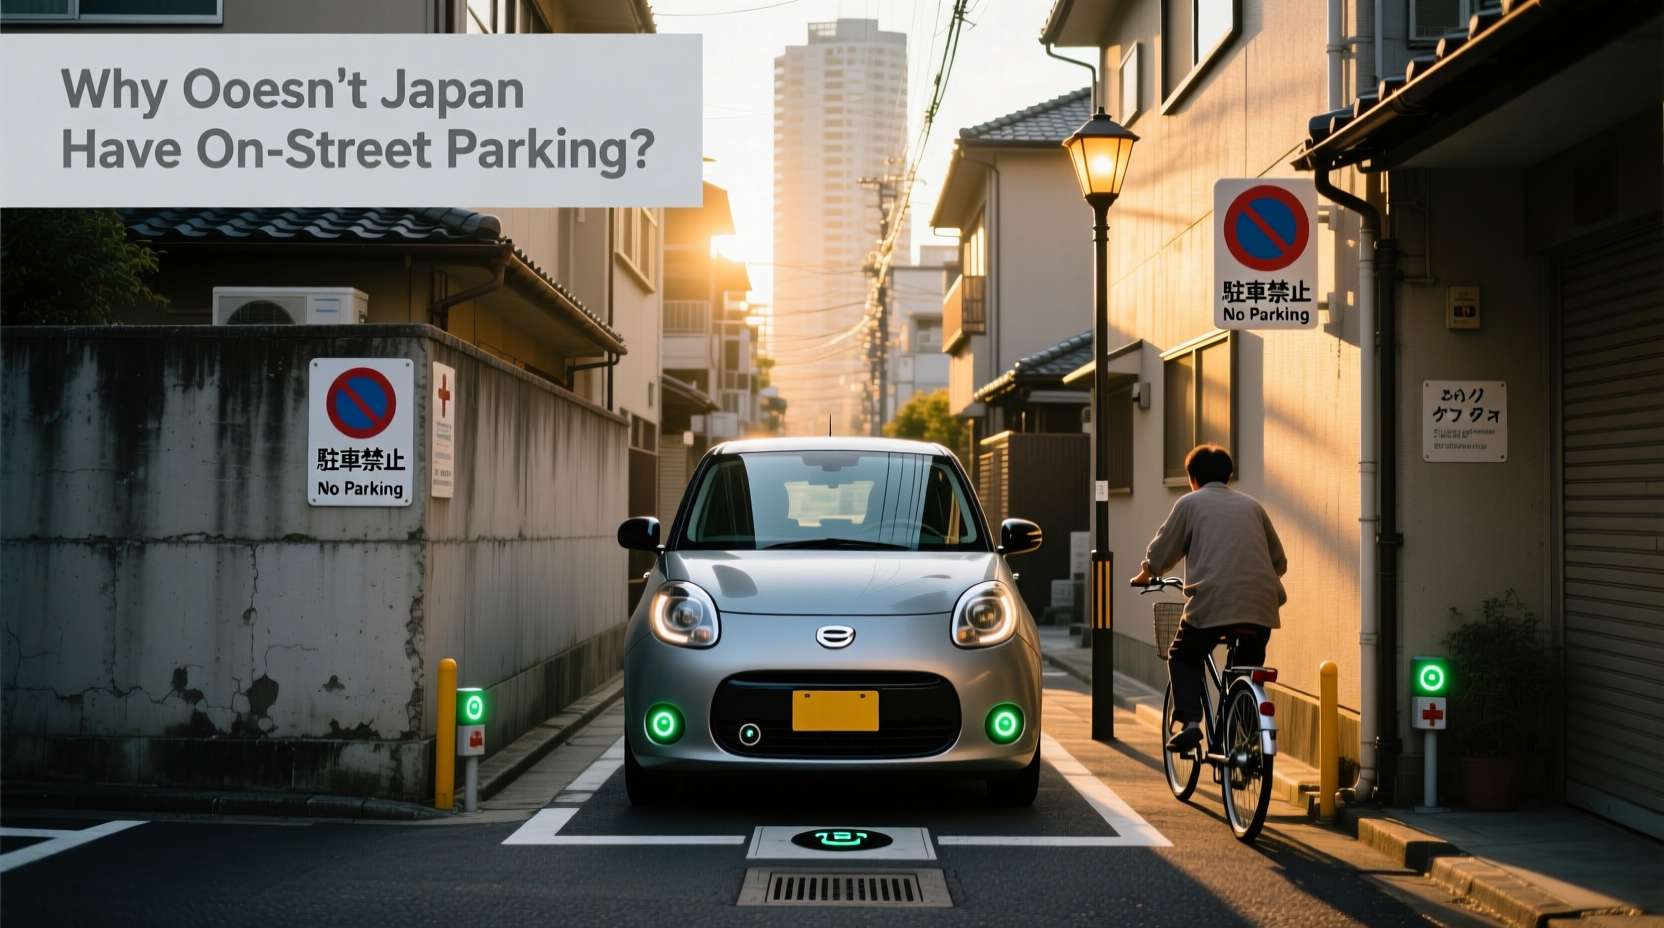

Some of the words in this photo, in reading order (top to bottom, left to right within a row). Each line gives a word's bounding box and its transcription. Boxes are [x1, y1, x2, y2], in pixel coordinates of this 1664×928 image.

[1222, 279, 1311, 304] 駐車禁止
[1224, 307, 1245, 321] No
[1250, 307, 1309, 325] Parking
[316, 447, 406, 472] 駐車禁止
[318, 481, 339, 495] No
[345, 481, 403, 499] Parking
